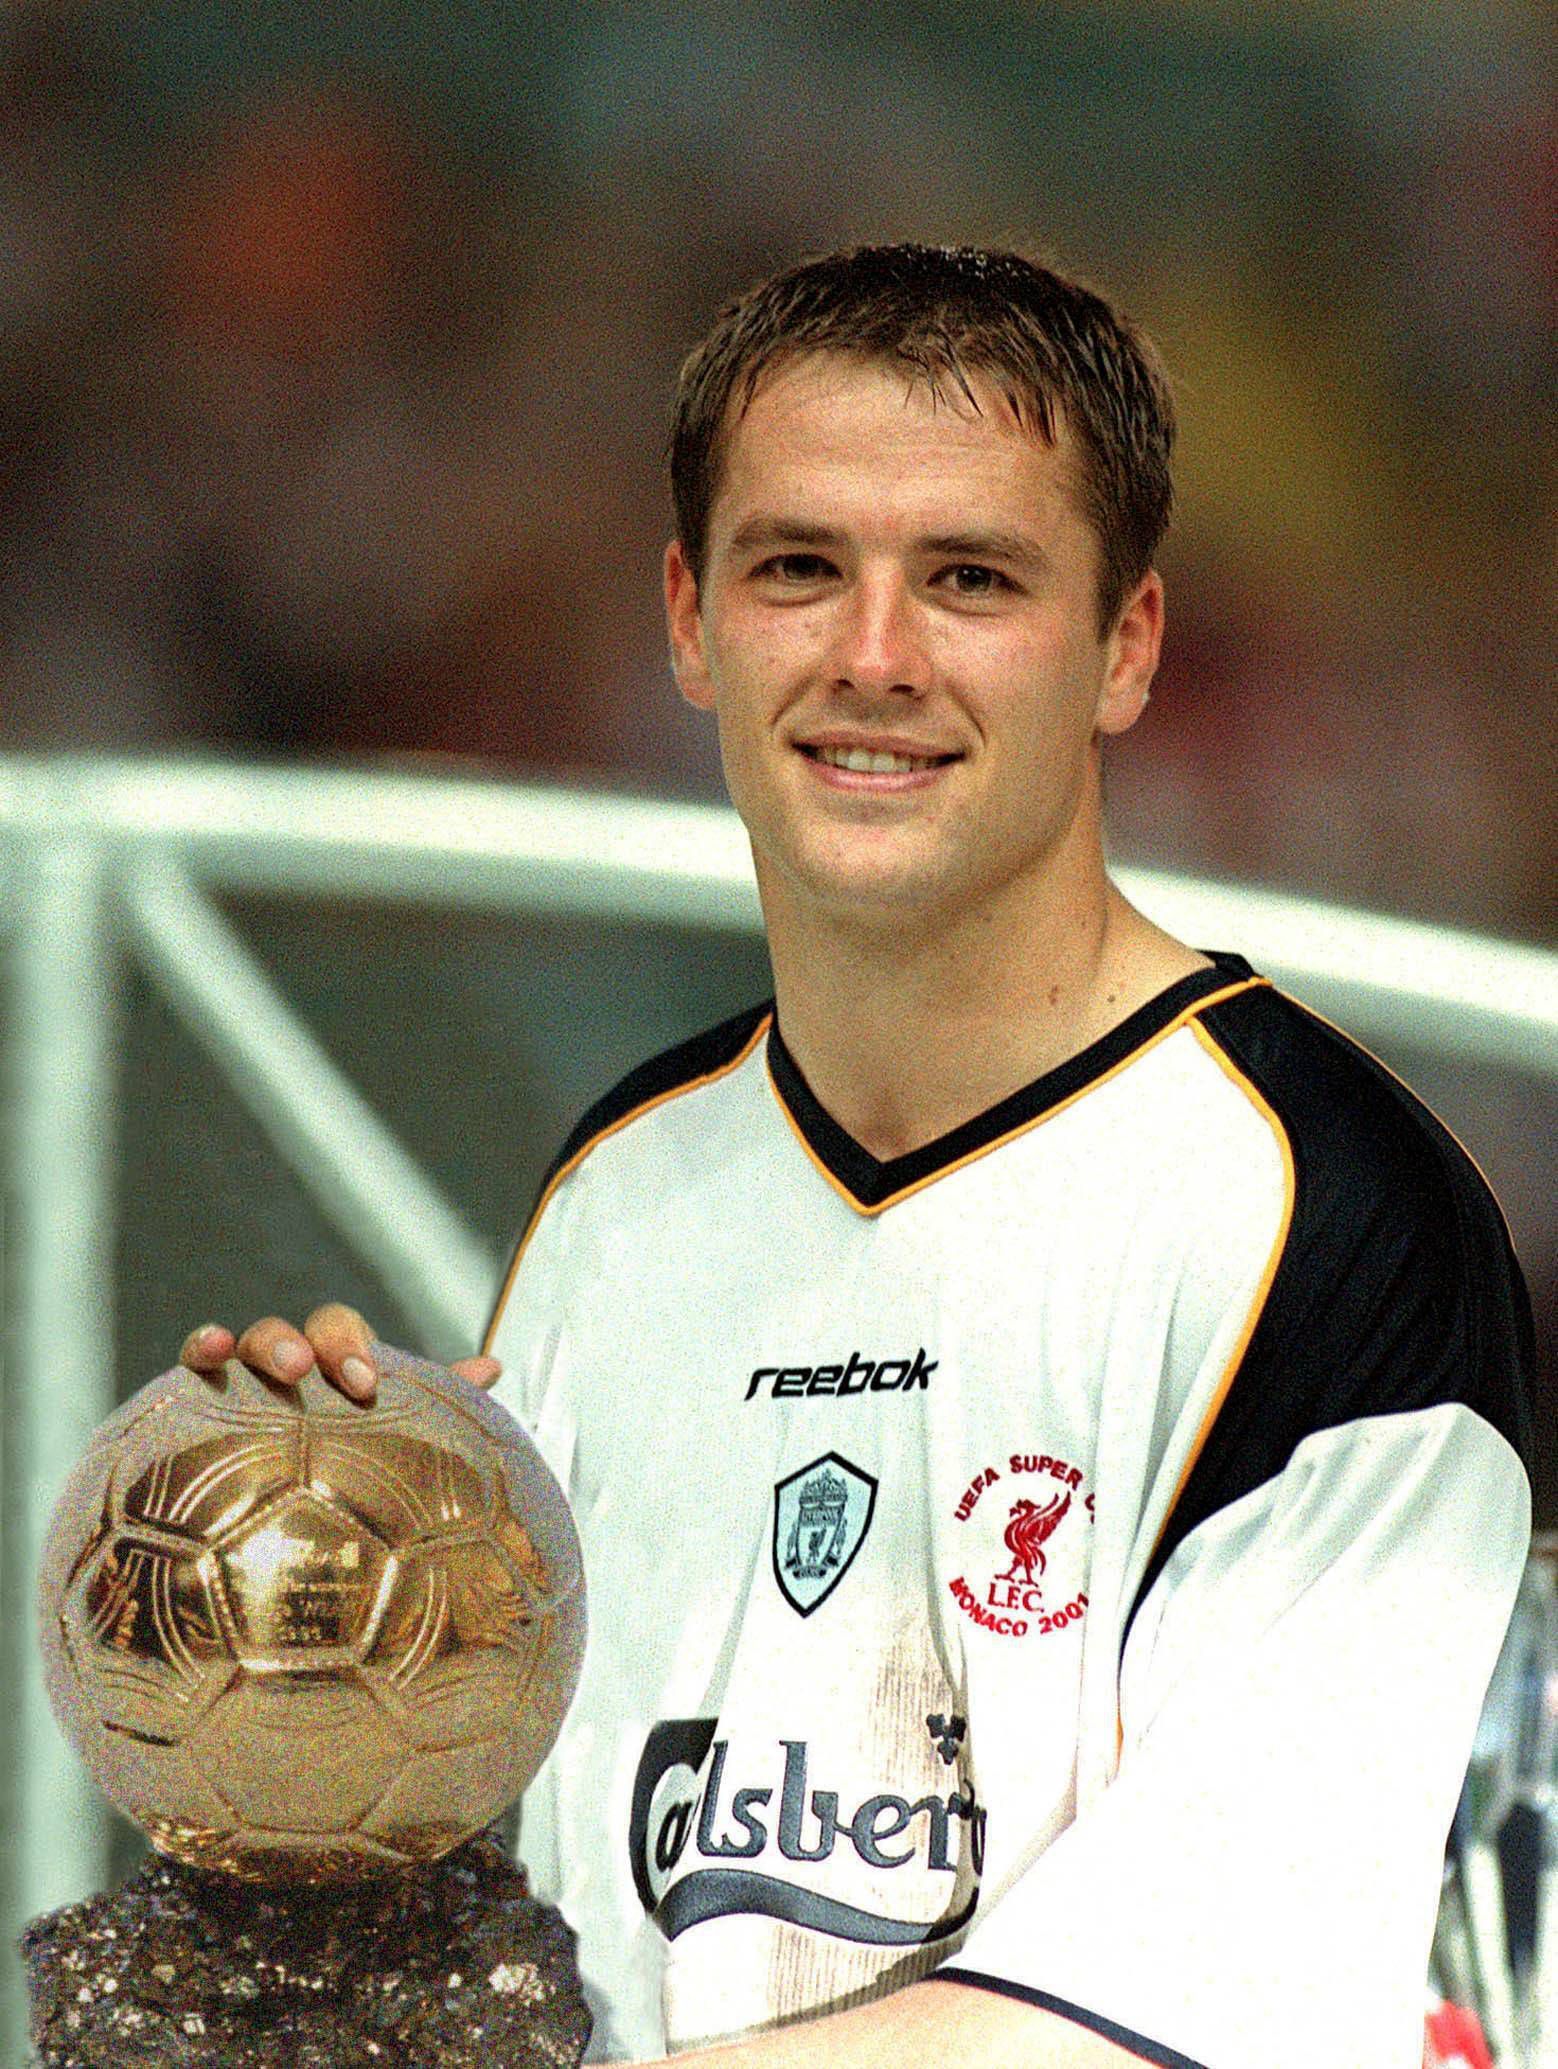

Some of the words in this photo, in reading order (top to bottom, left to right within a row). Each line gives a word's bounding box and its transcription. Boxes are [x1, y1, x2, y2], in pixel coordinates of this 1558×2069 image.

[744, 1347, 939, 1402] reebok
[954, 1466, 1001, 1522] UEFA
[1009, 1453, 1084, 1492] SUPER
[949, 1575, 1029, 1638] MONACO
[1038, 1592, 1090, 1635] 2001
[629, 1717, 987, 1935] Calsber
